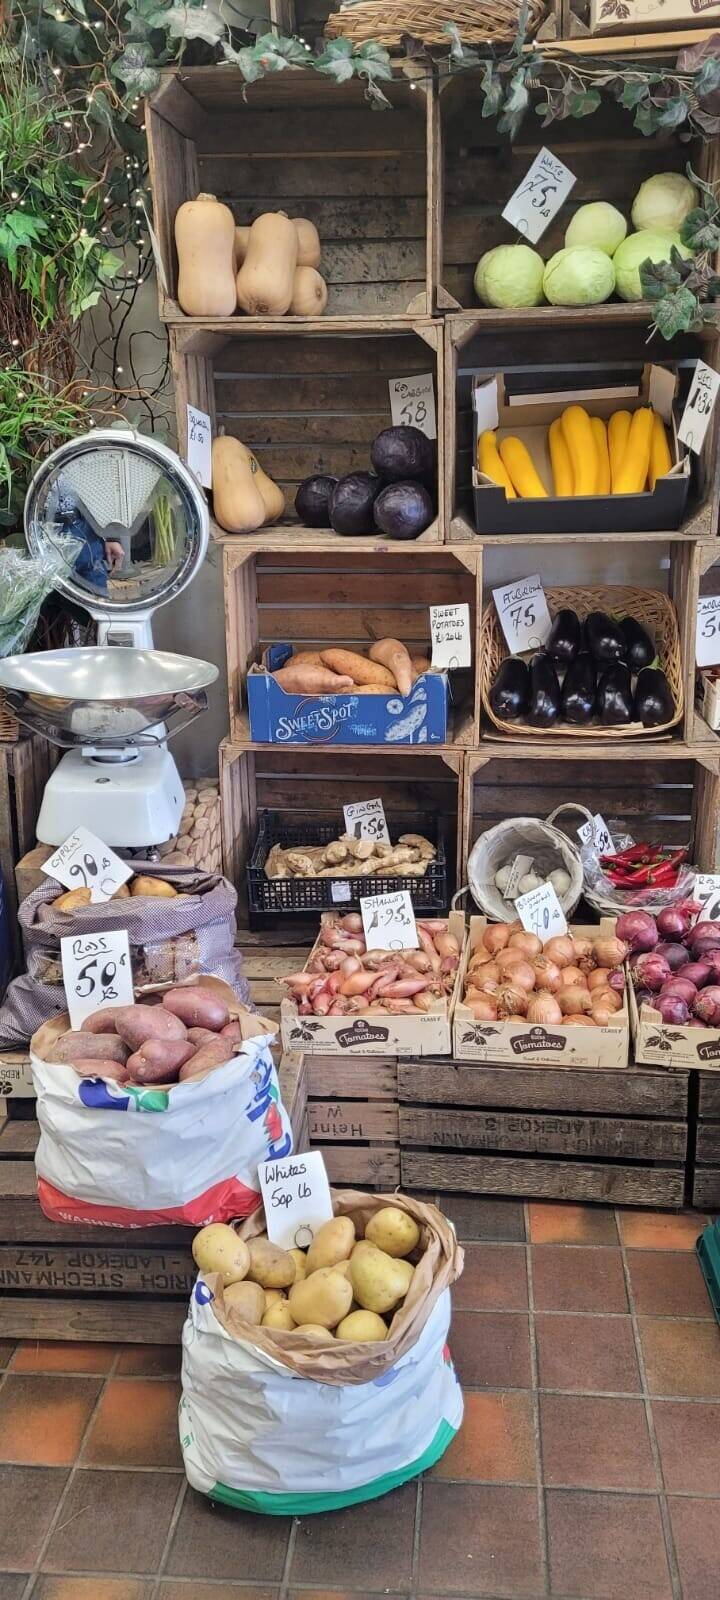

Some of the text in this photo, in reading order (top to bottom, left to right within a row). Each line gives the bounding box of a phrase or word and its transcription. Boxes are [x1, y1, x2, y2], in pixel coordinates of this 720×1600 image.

[516, 174, 557, 208] 75
[433, 608, 461, 618] SWEET
[510, 603, 536, 637] 75
[432, 619, 465, 630] POTATOES
[354, 818, 386, 840] 1.50
[70, 853, 98, 888] 90
[367, 903, 406, 933] 1.95
[340, 1031, 386, 1045] Tomatoes
[513, 1038, 563, 1051] Tomatoes
[265, 1163, 307, 1184] Whites
[271, 1182, 311, 1208] 50p lb
[15, 1251, 54, 1266] 147
[68, 1252, 167, 1270] LADEKOP
